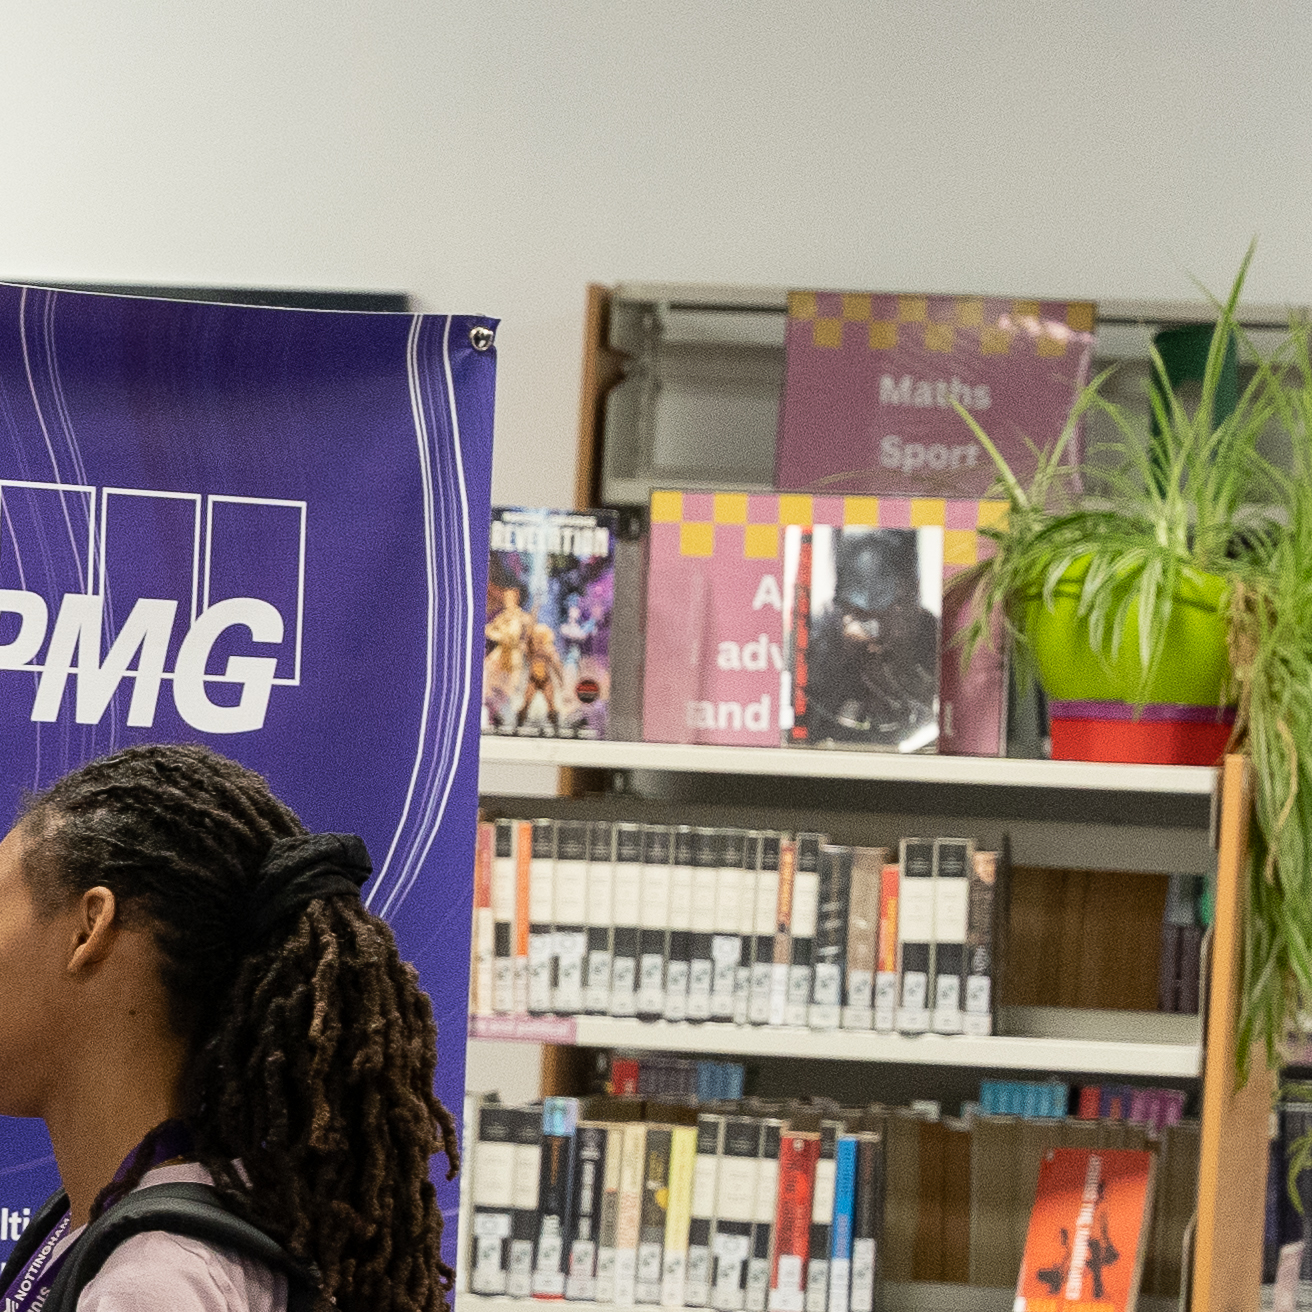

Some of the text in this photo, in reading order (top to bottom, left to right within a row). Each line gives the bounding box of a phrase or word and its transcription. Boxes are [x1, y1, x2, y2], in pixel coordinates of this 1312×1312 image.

[879, 374, 991, 410] Maths
[880, 435, 978, 475] Sport
[14, 1217, 70, 1302] NOTTINGHAM
